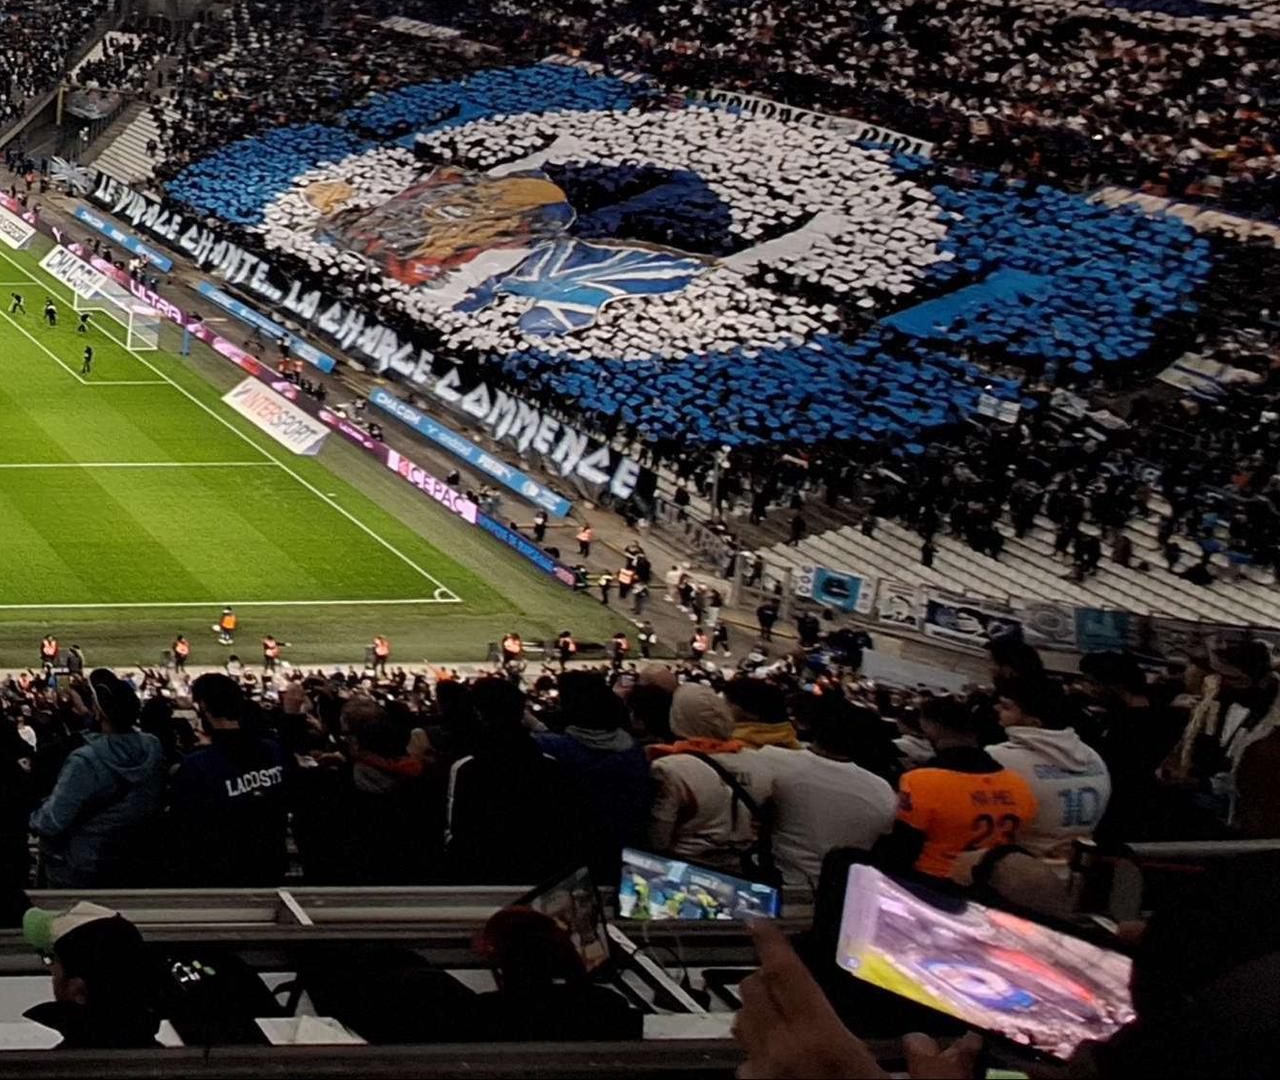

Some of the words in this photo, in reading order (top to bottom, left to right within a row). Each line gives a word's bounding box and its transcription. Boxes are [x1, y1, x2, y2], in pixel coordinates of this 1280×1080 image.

[130, 280, 182, 324] ULTRA
[282, 280, 321, 319] LA
[243, 387, 319, 444] INTERSPORT
[409, 465, 466, 515] CEPAC
[966, 813, 1021, 850] 23
